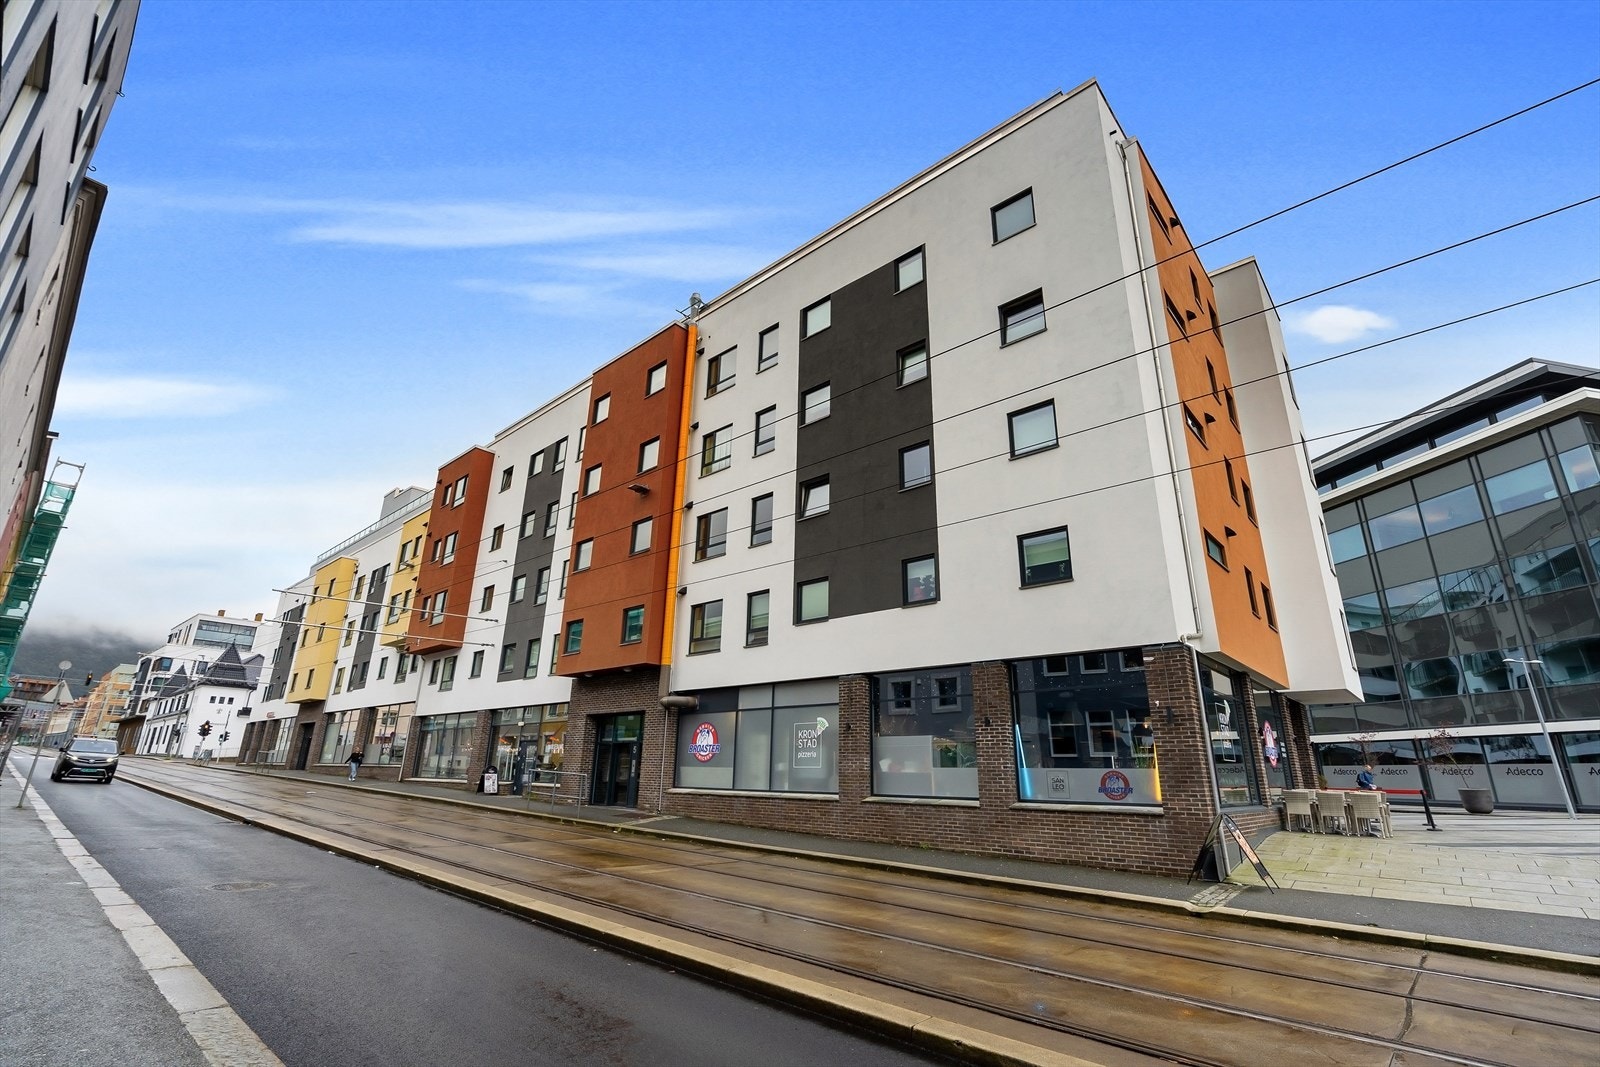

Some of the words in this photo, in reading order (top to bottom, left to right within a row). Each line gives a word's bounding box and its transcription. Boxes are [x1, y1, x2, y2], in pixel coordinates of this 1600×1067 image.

[798, 729, 817, 739] KRON
[798, 739, 818, 748] STAD
[688, 744, 721, 753] BROASTER
[797, 751, 817, 759] pizzeria
[1333, 768, 1358, 776] Adecco
[1440, 767, 1474, 776] Adecco
[1505, 767, 1544, 776] Adecco
[1098, 786, 1134, 795] BROASTER
